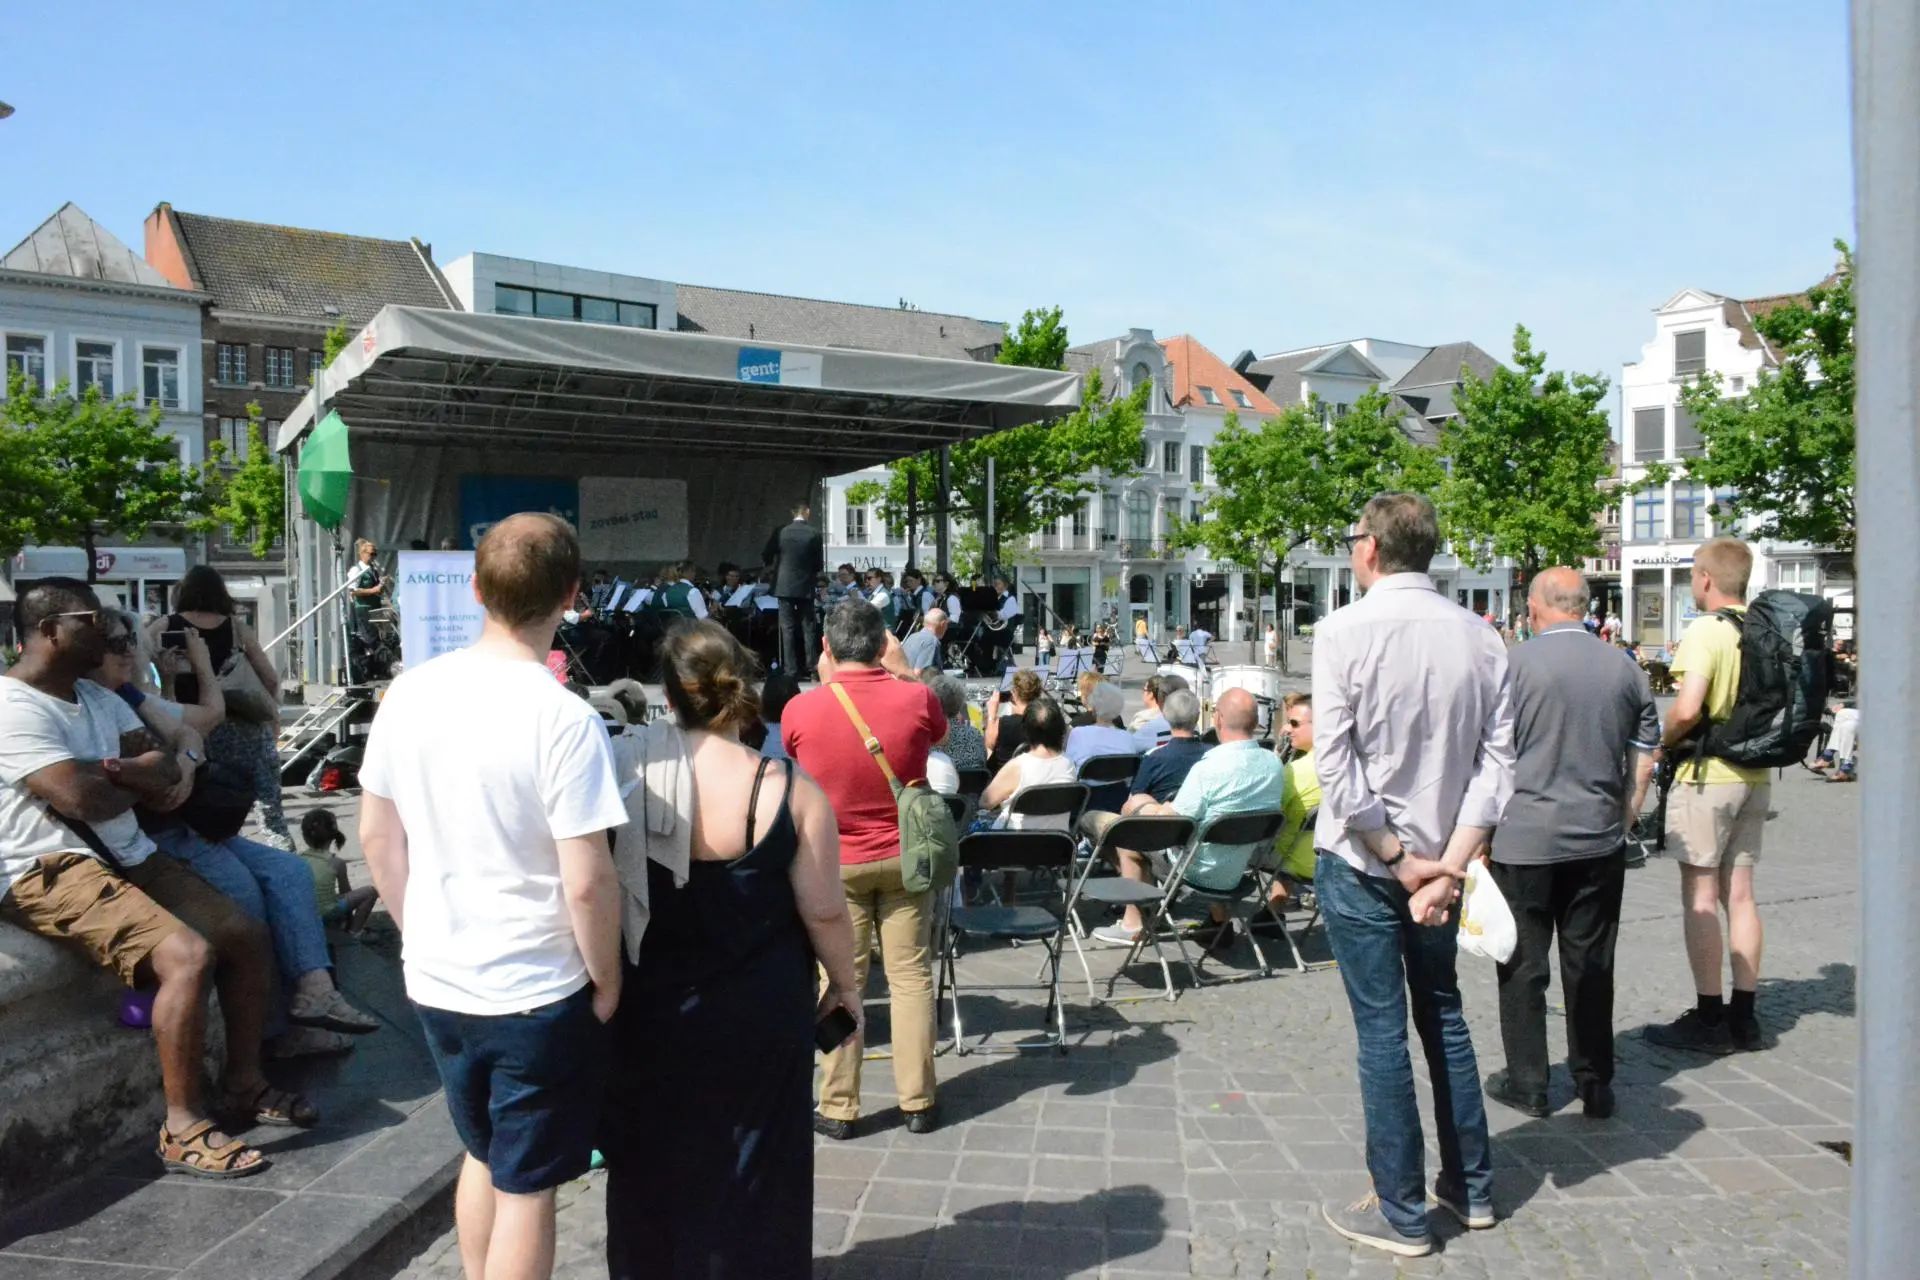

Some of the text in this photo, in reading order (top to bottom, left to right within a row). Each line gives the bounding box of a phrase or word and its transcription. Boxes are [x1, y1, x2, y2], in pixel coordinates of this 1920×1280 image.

[740, 361, 779, 380] gent:
[854, 556, 891, 568] PAUL
[1216, 562, 1257, 573] APOTHE
